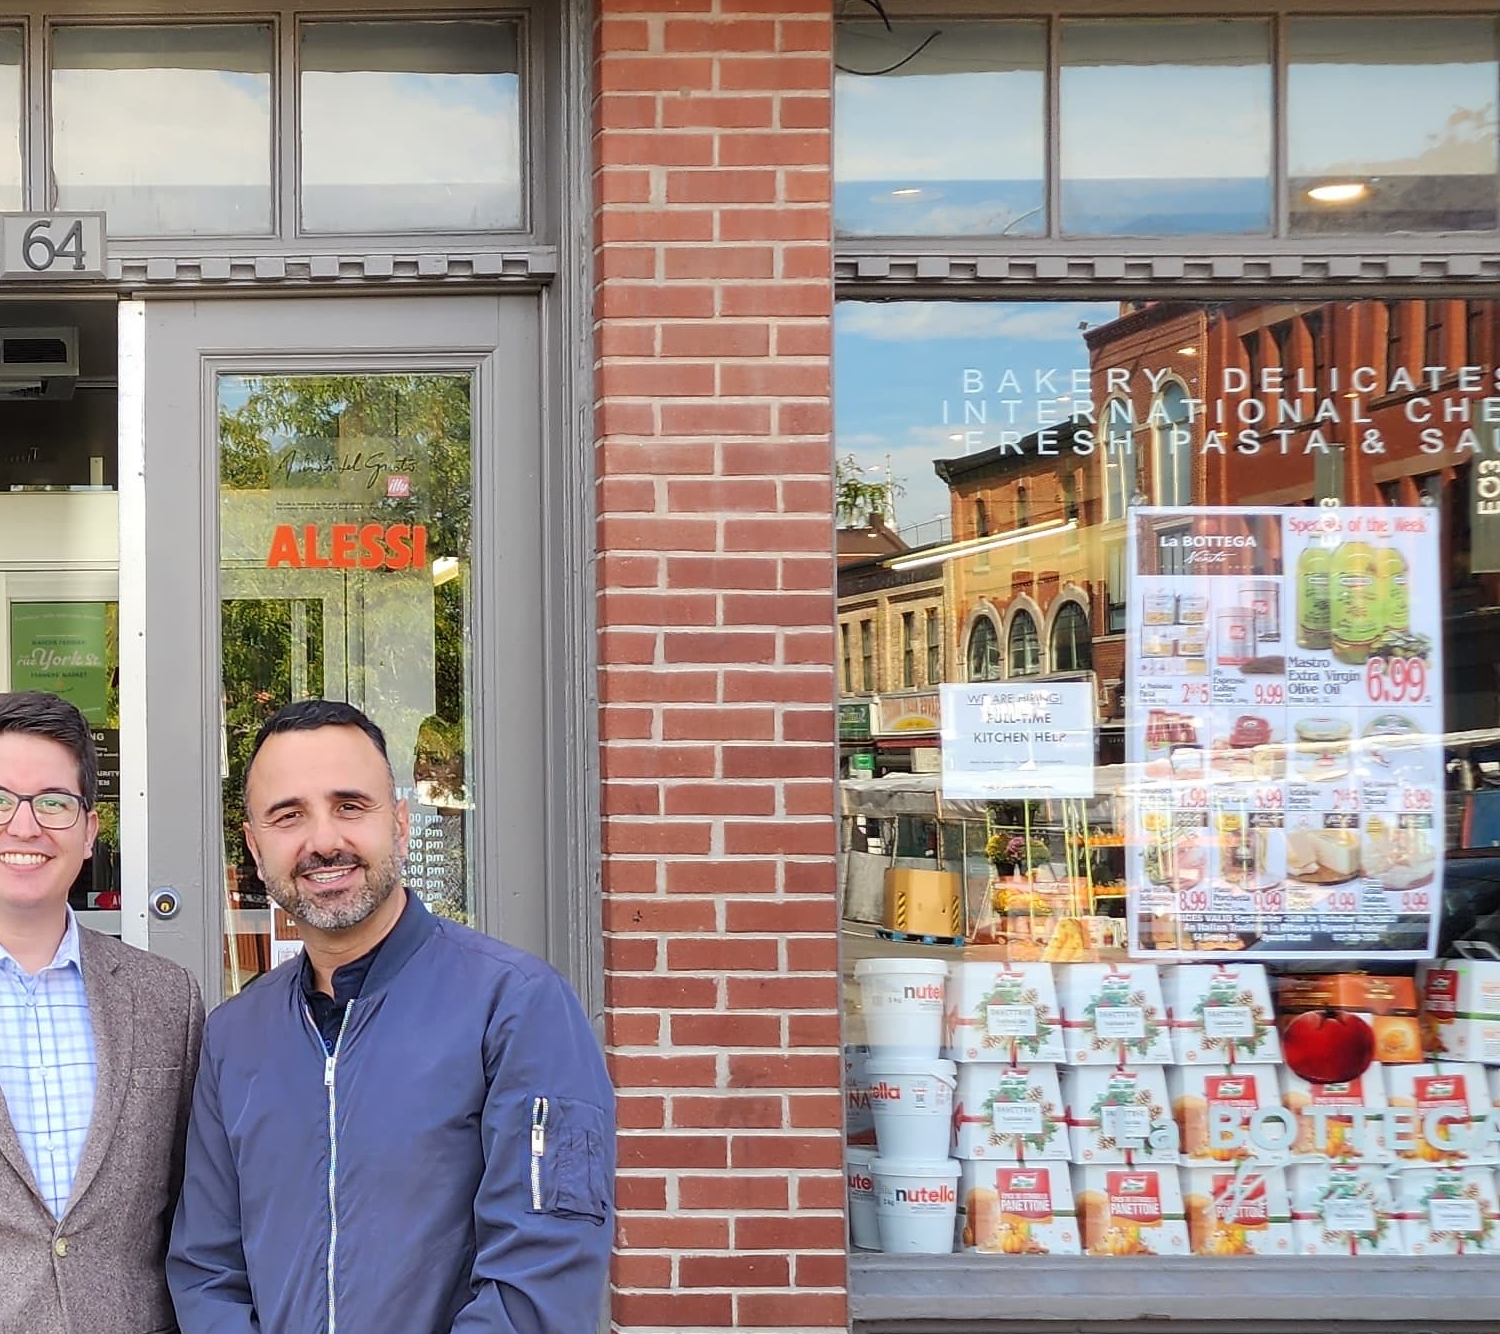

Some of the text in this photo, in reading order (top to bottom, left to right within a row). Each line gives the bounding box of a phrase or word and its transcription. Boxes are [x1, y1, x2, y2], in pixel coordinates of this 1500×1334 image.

[22, 219, 87, 271] 64
[963, 366, 1500, 393] BAKERY DELICATE
[942, 397, 1372, 424] INTERNATIONAL
[965, 428, 1500, 455] FRESH PASTA & SA
[389, 477, 409, 493] illy
[267, 523, 428, 571] ALESSI
[1159, 535, 1257, 548] La BOTTEGA
[31, 647, 82, 671] York
[1288, 656, 1331, 668] Mastro
[1288, 669, 1361, 685] Extra Virgin
[1366, 656, 1426, 703] 6.99
[1288, 683, 1342, 695] Olive Oil
[992, 695, 1013, 704] ARE
[987, 713, 1052, 724] FULL-TIME
[973, 731, 1067, 743] KITCHEN HELP
[425, 815, 443, 825] pm
[425, 828, 443, 839] pm
[425, 841, 444, 851] pm
[425, 853, 444, 864] pm
[426, 866, 445, 877] pm
[426, 879, 445, 890] pm
[1115, 1105, 1180, 1149] La
[895, 1185, 955, 1204] nutella
[1001, 1199, 1051, 1212] PANETTONE
[1110, 1203, 1161, 1214] PANETTONE
